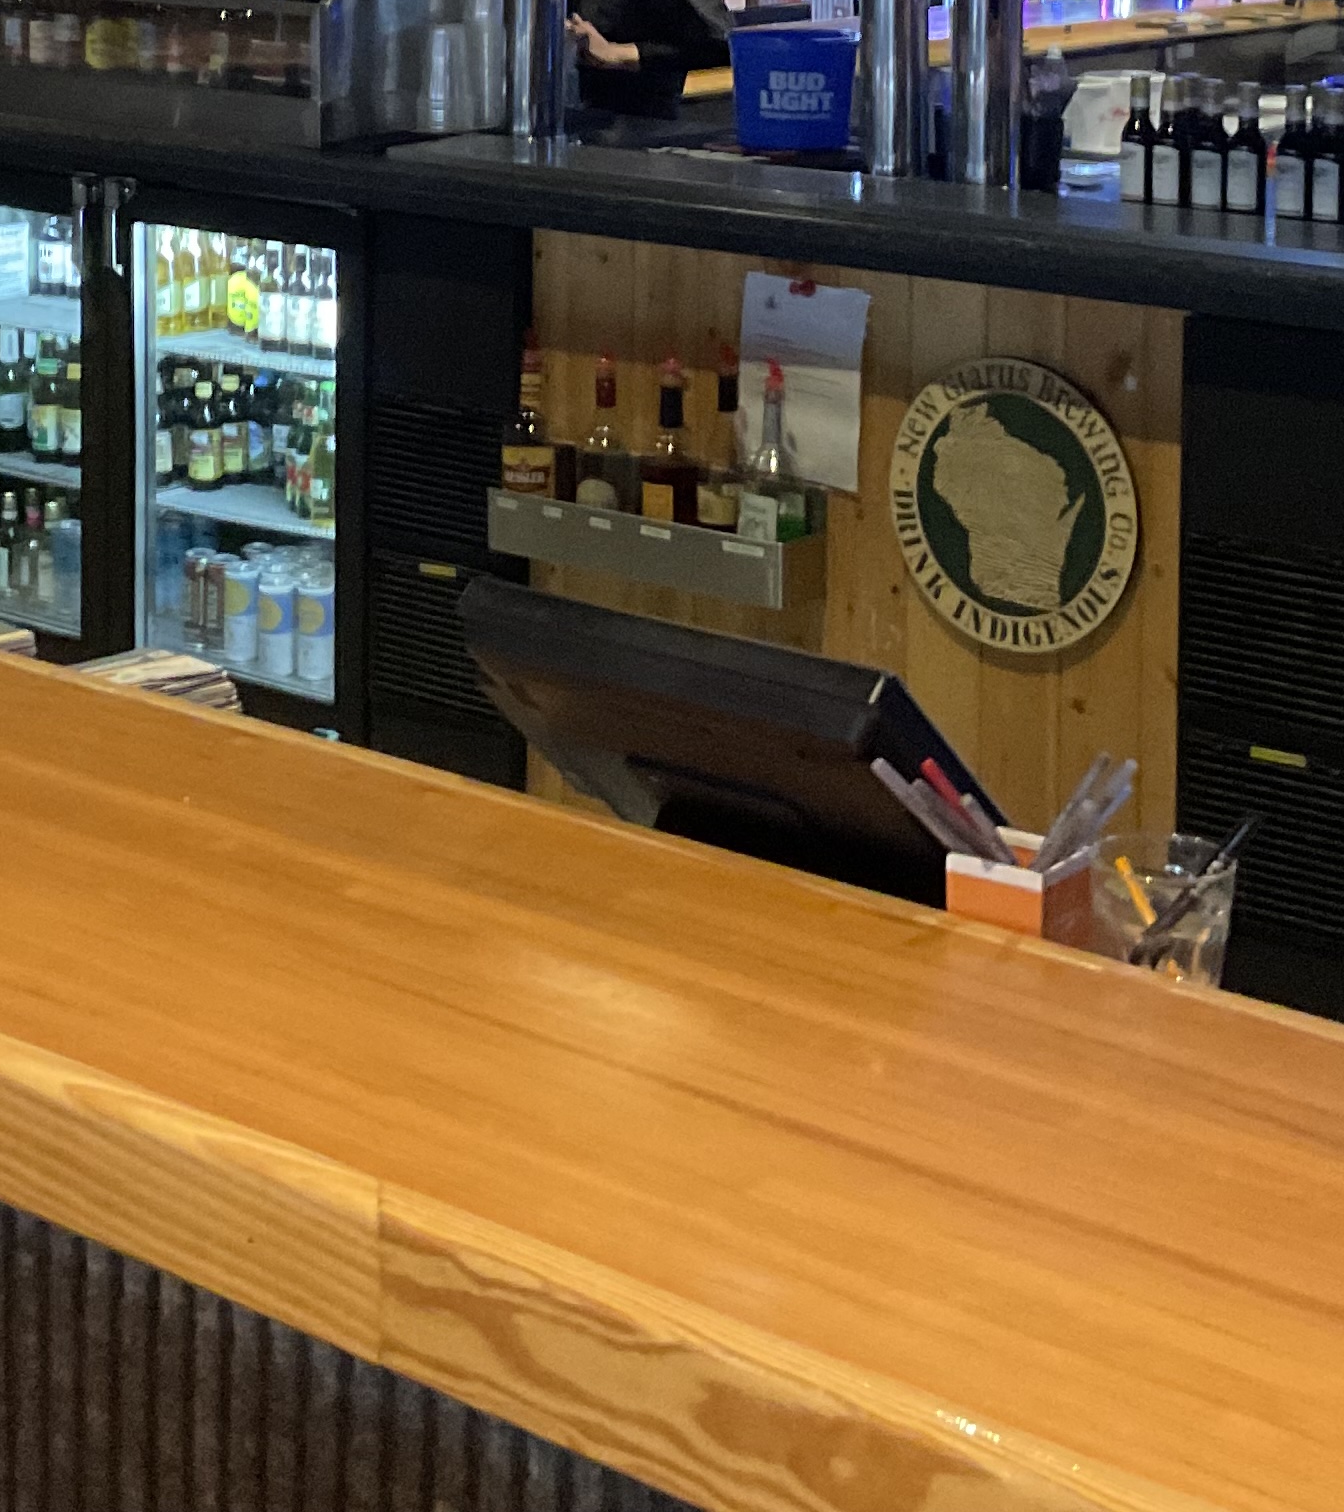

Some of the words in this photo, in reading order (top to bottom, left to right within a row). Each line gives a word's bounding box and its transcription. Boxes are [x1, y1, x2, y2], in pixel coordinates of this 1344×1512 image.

[769, 70, 826, 90] BUD
[759, 89, 834, 111] LIGHT
[893, 489, 942, 601] DRINK
[953, 562, 1120, 647] INDIGENOUS
